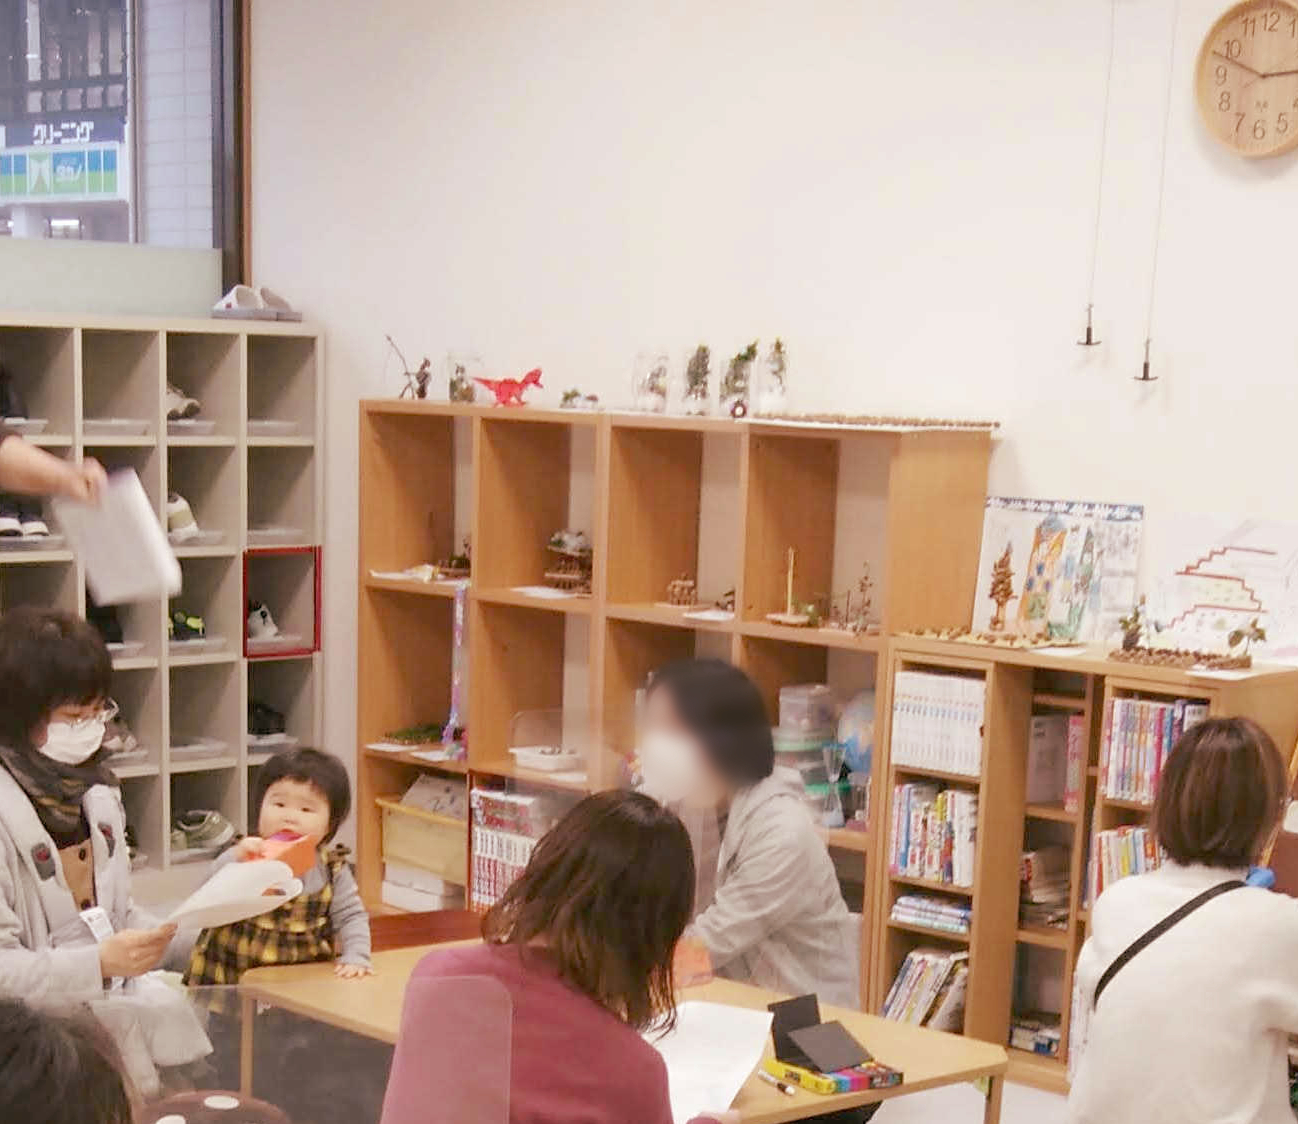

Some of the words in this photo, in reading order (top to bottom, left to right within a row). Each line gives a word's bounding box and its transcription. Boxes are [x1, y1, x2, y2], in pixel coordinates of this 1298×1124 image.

[1242, 17, 1256, 37] 11
[1262, 11, 1280, 32] 12
[1289, 18, 1296, 38] 1
[1224, 39, 1242, 58] 10
[1215, 65, 1227, 86] 9
[1218, 91, 1231, 112] 8
[33, 121, 94, 145] クリーニング
[1235, 112, 1246, 133] 7
[1253, 119, 1265, 140] 6
[1276, 112, 1288, 133] 5
